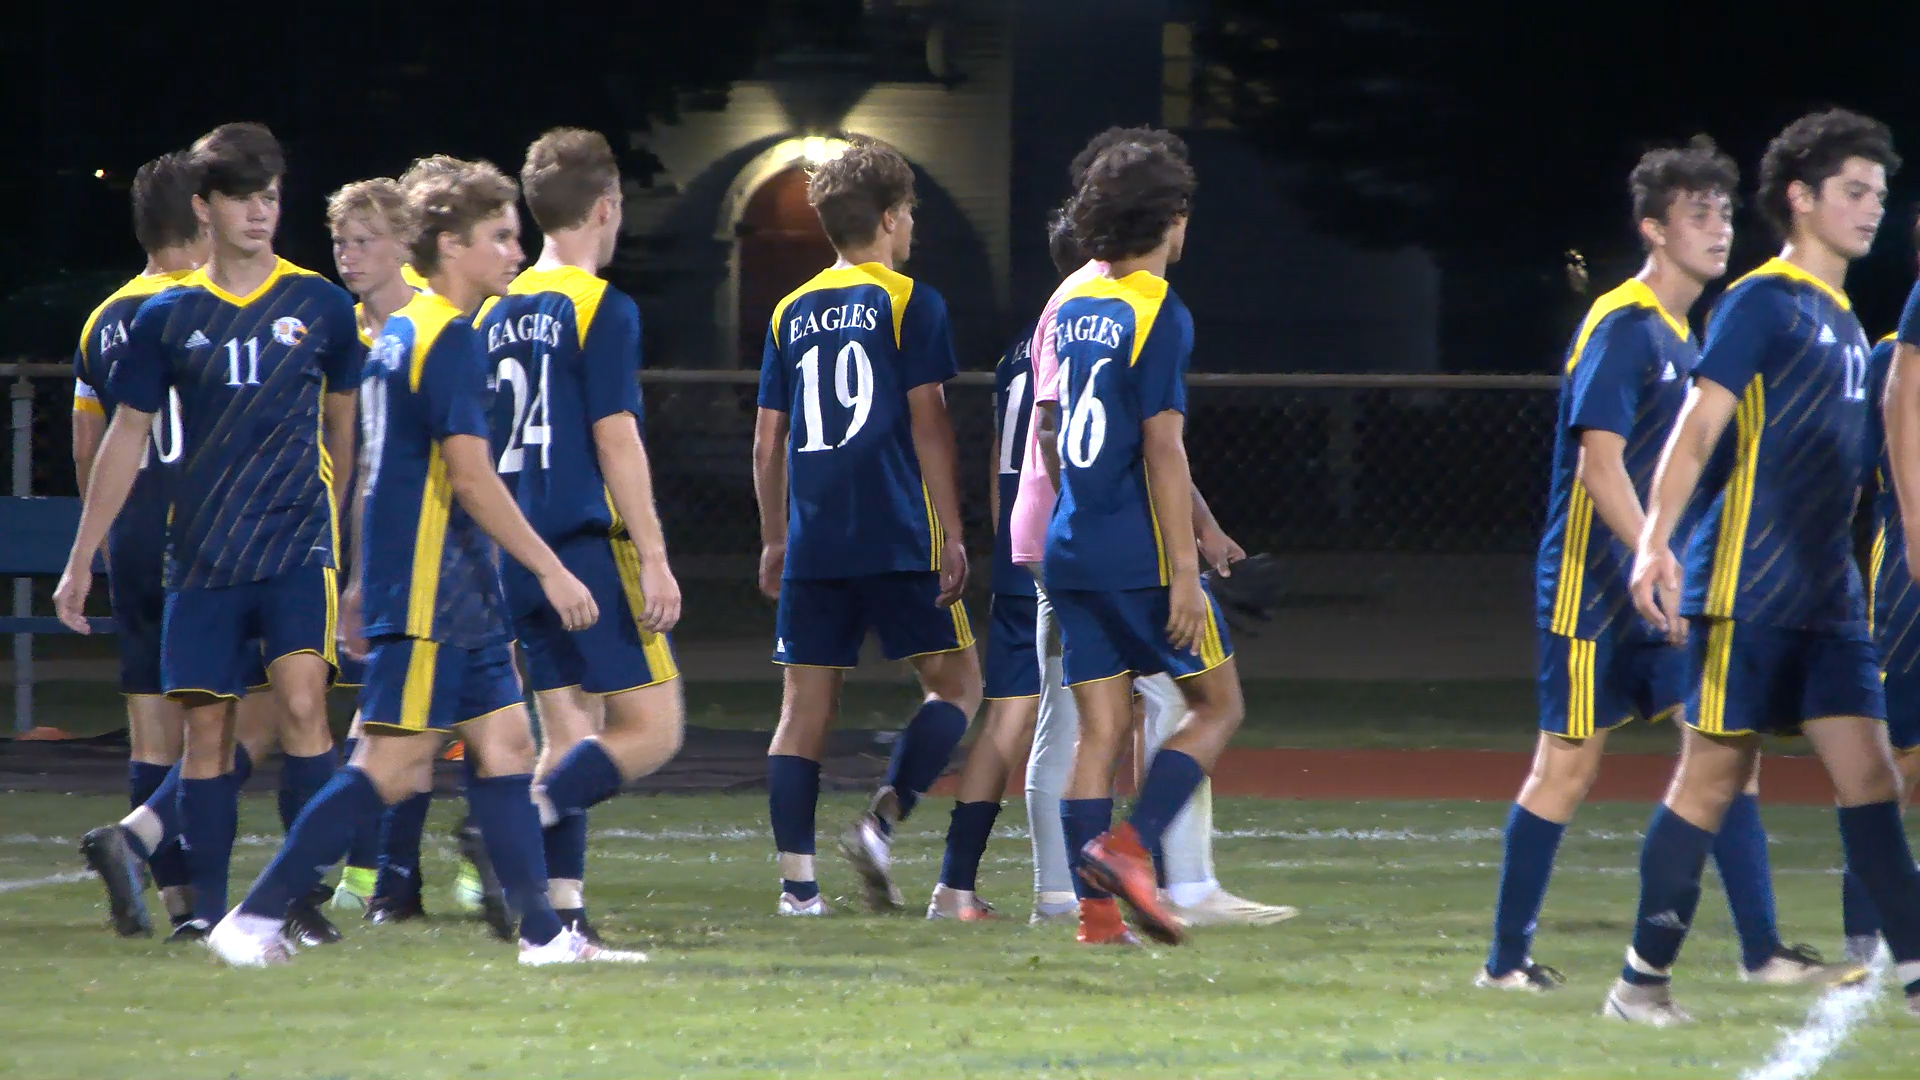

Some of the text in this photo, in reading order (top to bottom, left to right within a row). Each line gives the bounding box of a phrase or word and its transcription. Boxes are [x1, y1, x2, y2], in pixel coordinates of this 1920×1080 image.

[223, 336, 261, 386] 11
[488, 313, 562, 352] EAGLES
[789, 303, 878, 344] EAGLES
[496, 353, 551, 473] 24
[795, 340, 874, 452] 19
[998, 371, 1028, 474] 1
[1057, 357, 1112, 469] 16
